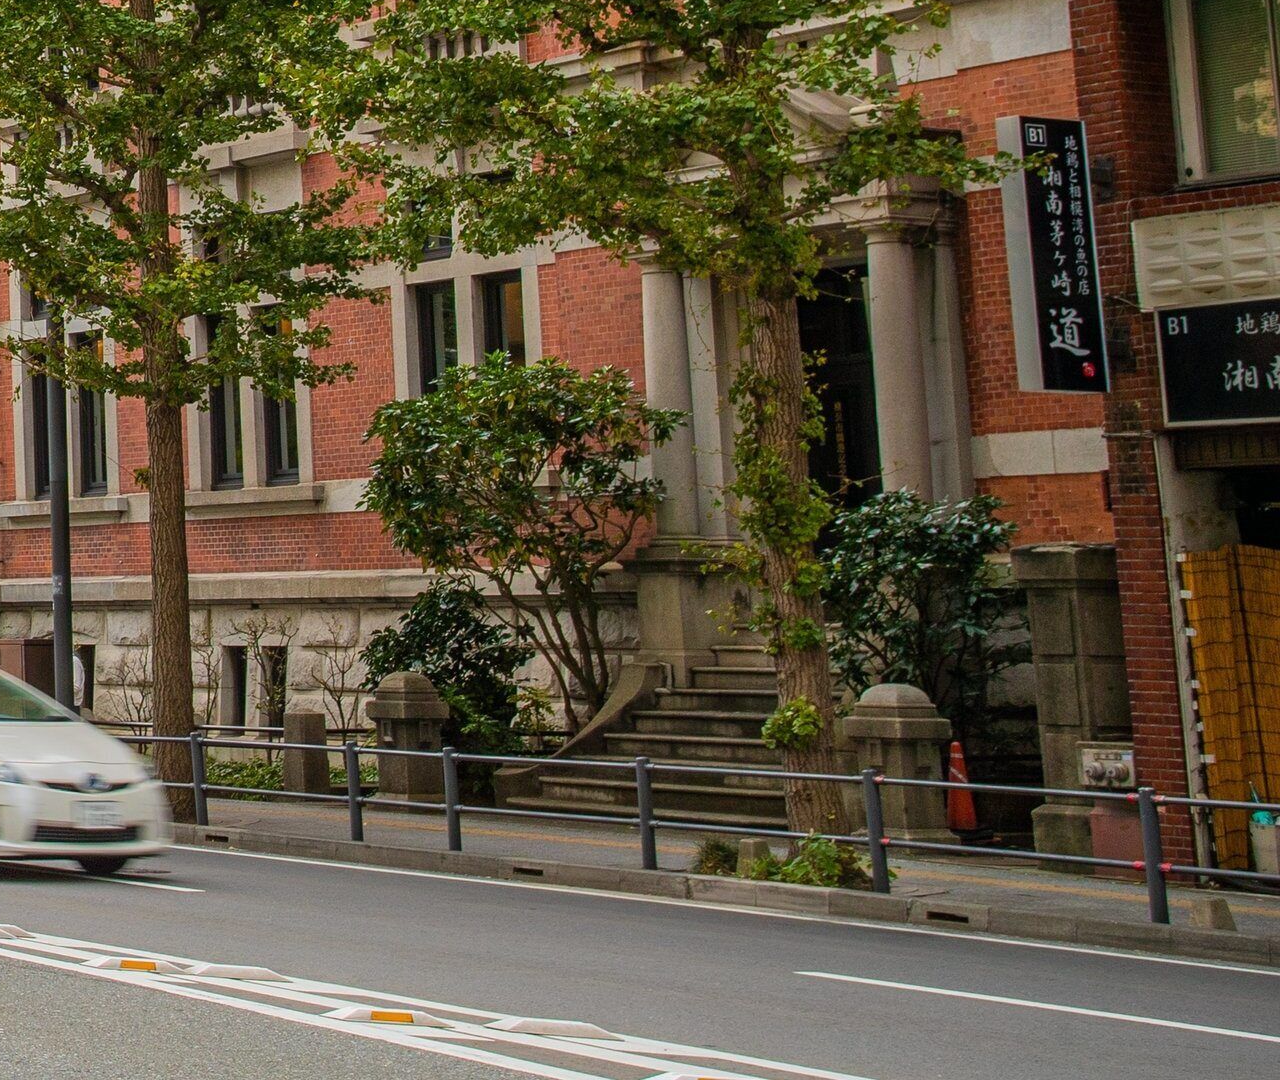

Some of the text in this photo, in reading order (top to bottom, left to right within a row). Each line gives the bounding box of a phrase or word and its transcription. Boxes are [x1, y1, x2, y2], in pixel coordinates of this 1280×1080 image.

[1028, 127, 1044, 143] B1
[1049, 307, 1090, 357] 道
[1167, 316, 1188, 335] B1
